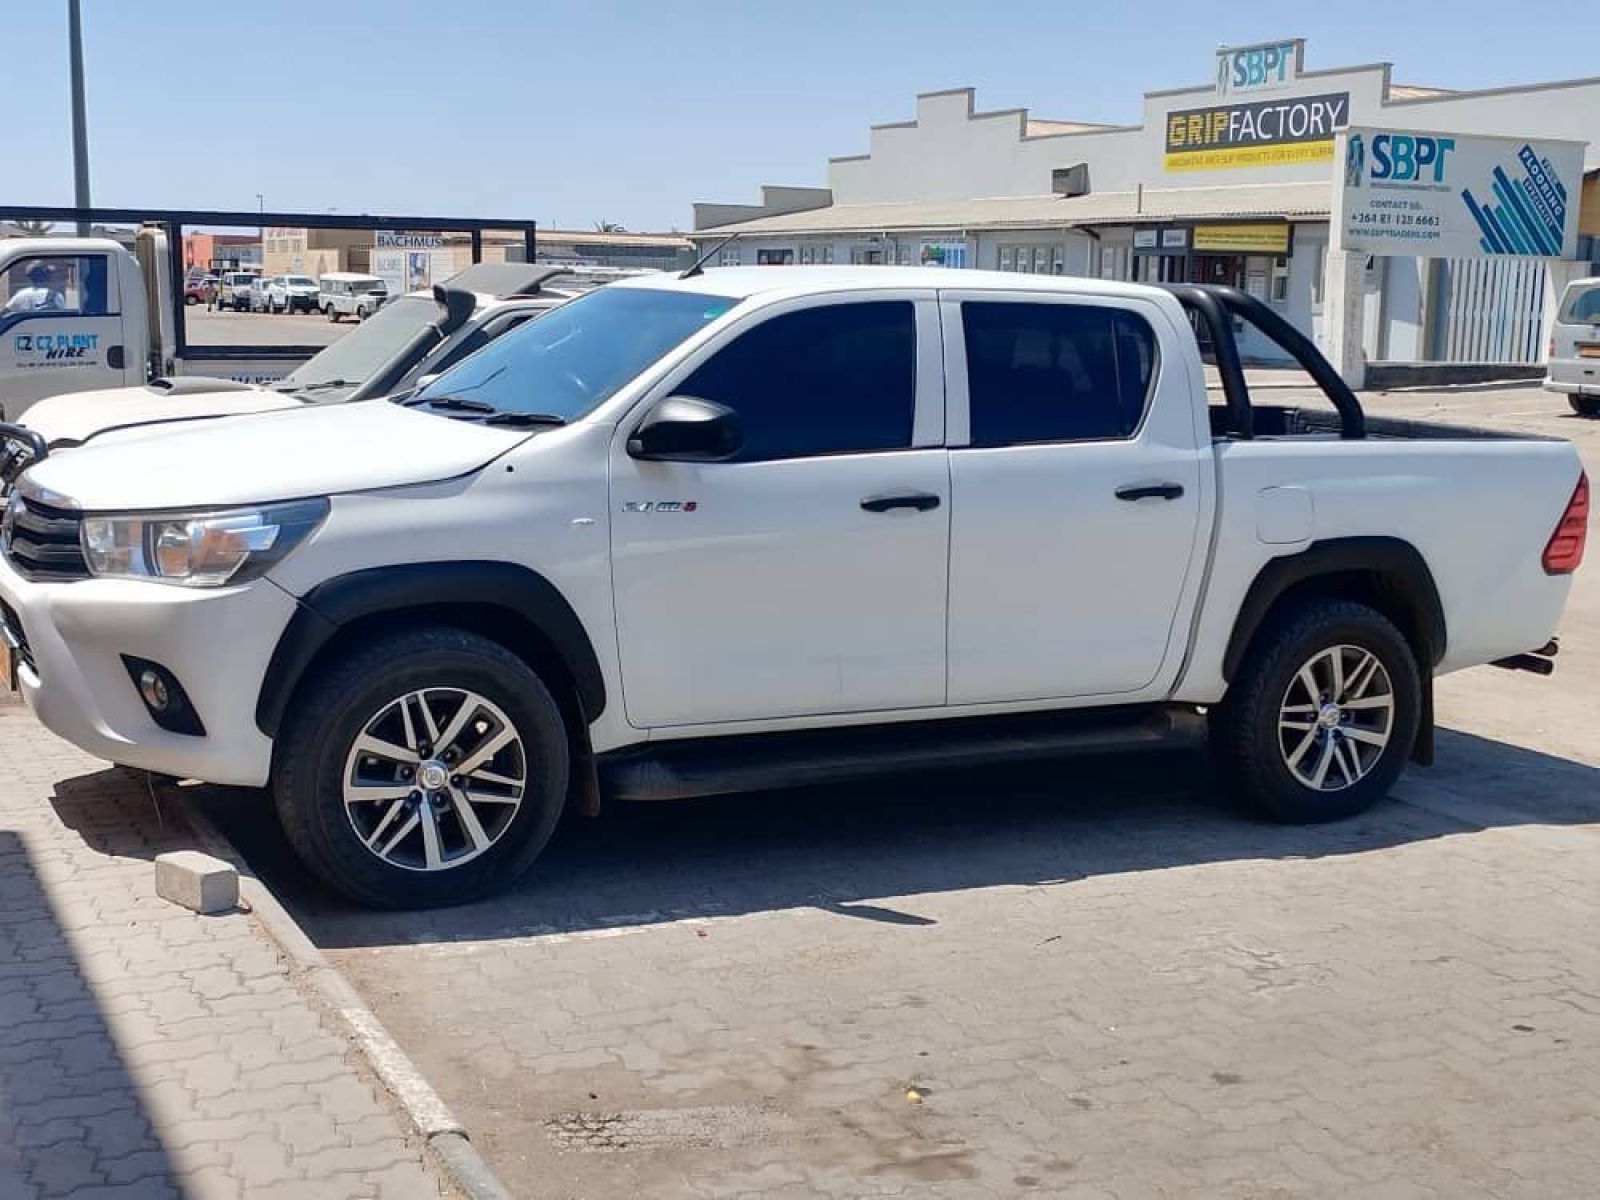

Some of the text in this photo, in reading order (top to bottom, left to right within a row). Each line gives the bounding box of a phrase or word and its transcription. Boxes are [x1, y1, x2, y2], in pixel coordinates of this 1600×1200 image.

[1233, 45, 1293, 87] SBPT
[1370, 135, 1455, 182] SBPT
[1521, 150, 1563, 216] FLOORING
[46, 347, 87, 359] HIRE
